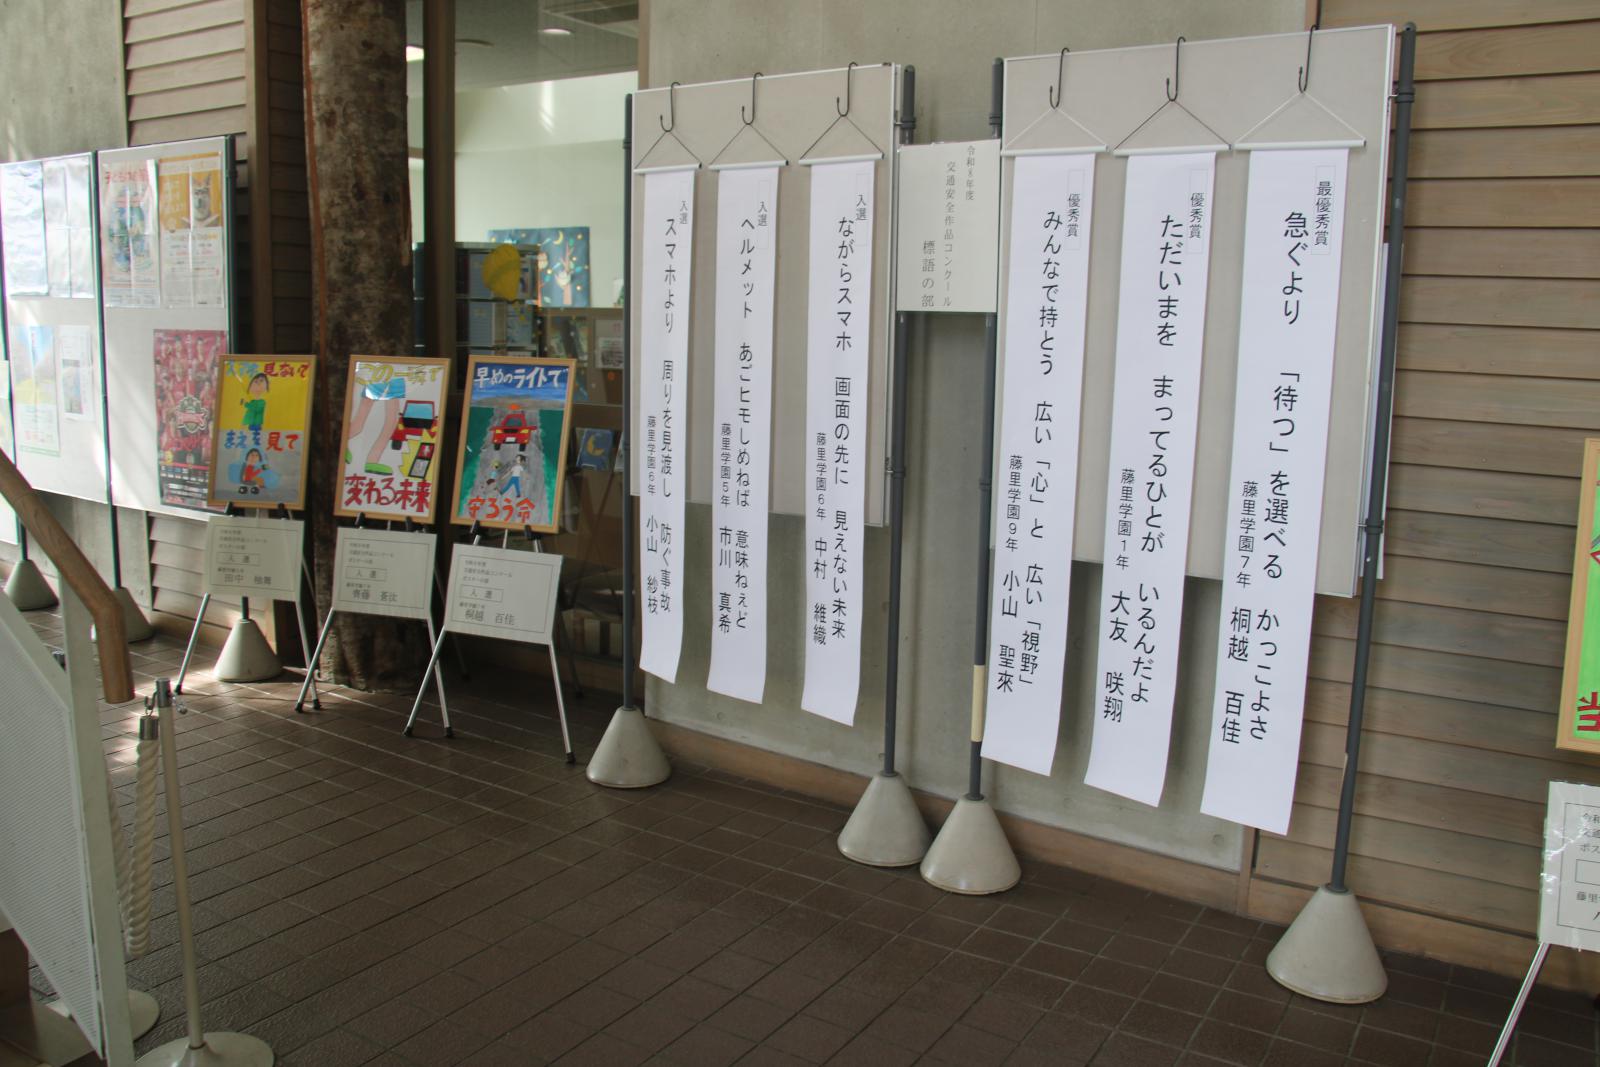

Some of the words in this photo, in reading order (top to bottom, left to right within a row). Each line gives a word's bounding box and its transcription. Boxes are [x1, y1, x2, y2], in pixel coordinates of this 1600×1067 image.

[679, 200, 689, 225] 入選
[757, 201, 768, 227] 入選
[855, 194, 868, 221] 入選
[943, 161, 956, 307] 交通安全作品コンクール
[1066, 193, 1081, 238] 優秀賞
[1188, 193, 1205, 239] 優秀賞
[1314, 181, 1332, 246] 最優秀賞
[664, 218, 677, 334] スマホより
[740, 218, 755, 319] ヘルメット
[836, 216, 854, 351] ながらスマホ
[922, 240, 935, 307] 標語の部
[1039, 211, 1063, 376] みんなで持とう
[1157, 215, 1184, 347] ただいまを
[1282, 211, 1309, 325] 急ぐより
[473, 366, 569, 389] 早めのライトで
[661, 360, 674, 498] 周りを見渡し
[720, 423, 732, 508] 藤里学園5年
[736, 342, 753, 507] あごヒモしめねば
[834, 376, 851, 485] 画面の先に
[1141, 375, 1174, 553] まってるひとが
[466, 495, 536, 524] 守ろう命
[816, 432, 827, 521] 藤里学園6年
[1005, 454, 1022, 552] 藤里学園9年
[1029, 401, 1053, 539] 広い「心」と
[1263, 372, 1300, 579] 「待つ」を選べる
[646, 514, 659, 553] 小山
[719, 525, 733, 569] 市川
[814, 537, 828, 580] 中村
[1115, 468, 1135, 571] 藤里学園1年
[1236, 481, 1259, 589] 藤里学園7年
[660, 523, 673, 613] 防ぐ事故
[719, 591, 732, 634] 真希
[832, 510, 848, 639] 見えない未来
[1002, 570, 1020, 618] 小山
[1019, 564, 1044, 685] 広い「視野」
[1109, 590, 1131, 643] 大友
[1131, 583, 1160, 703] いるんだよ
[1228, 606, 1252, 662] 桐越
[1103, 672, 1124, 723] 咲翔
[1221, 691, 1245, 744] 百佳
[1250, 609, 1280, 740] かっこよさ
